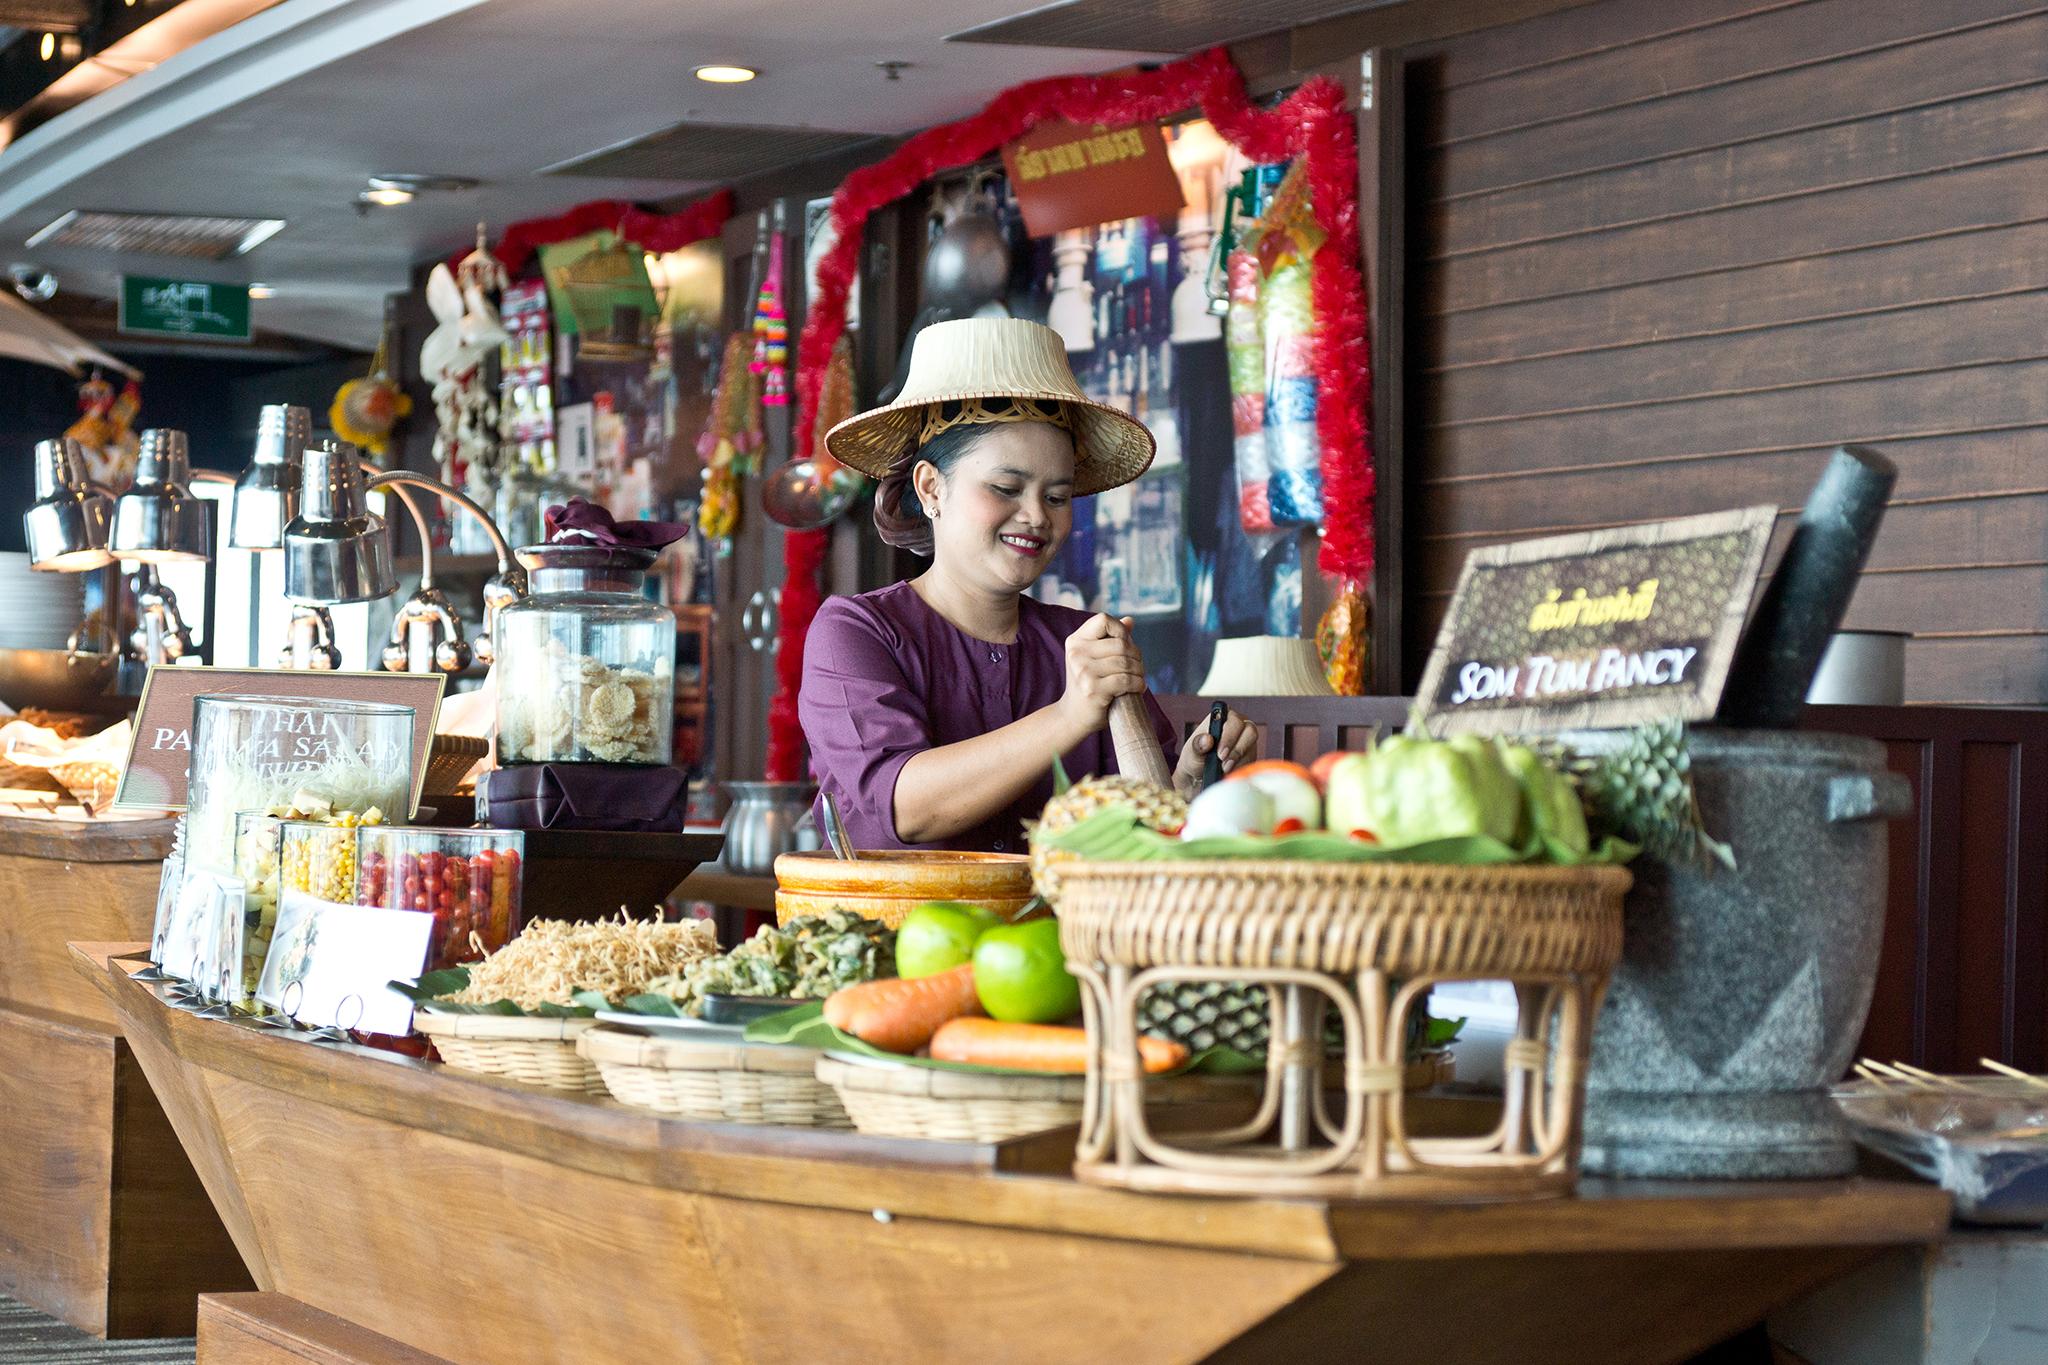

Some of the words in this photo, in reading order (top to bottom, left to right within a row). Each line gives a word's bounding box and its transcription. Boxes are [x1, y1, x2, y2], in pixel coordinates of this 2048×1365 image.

[1452, 661, 1519, 704] SOM
[1523, 655, 1592, 698] TUM
[1590, 646, 1697, 692] FANCY
[293, 735, 399, 762] SAAD
